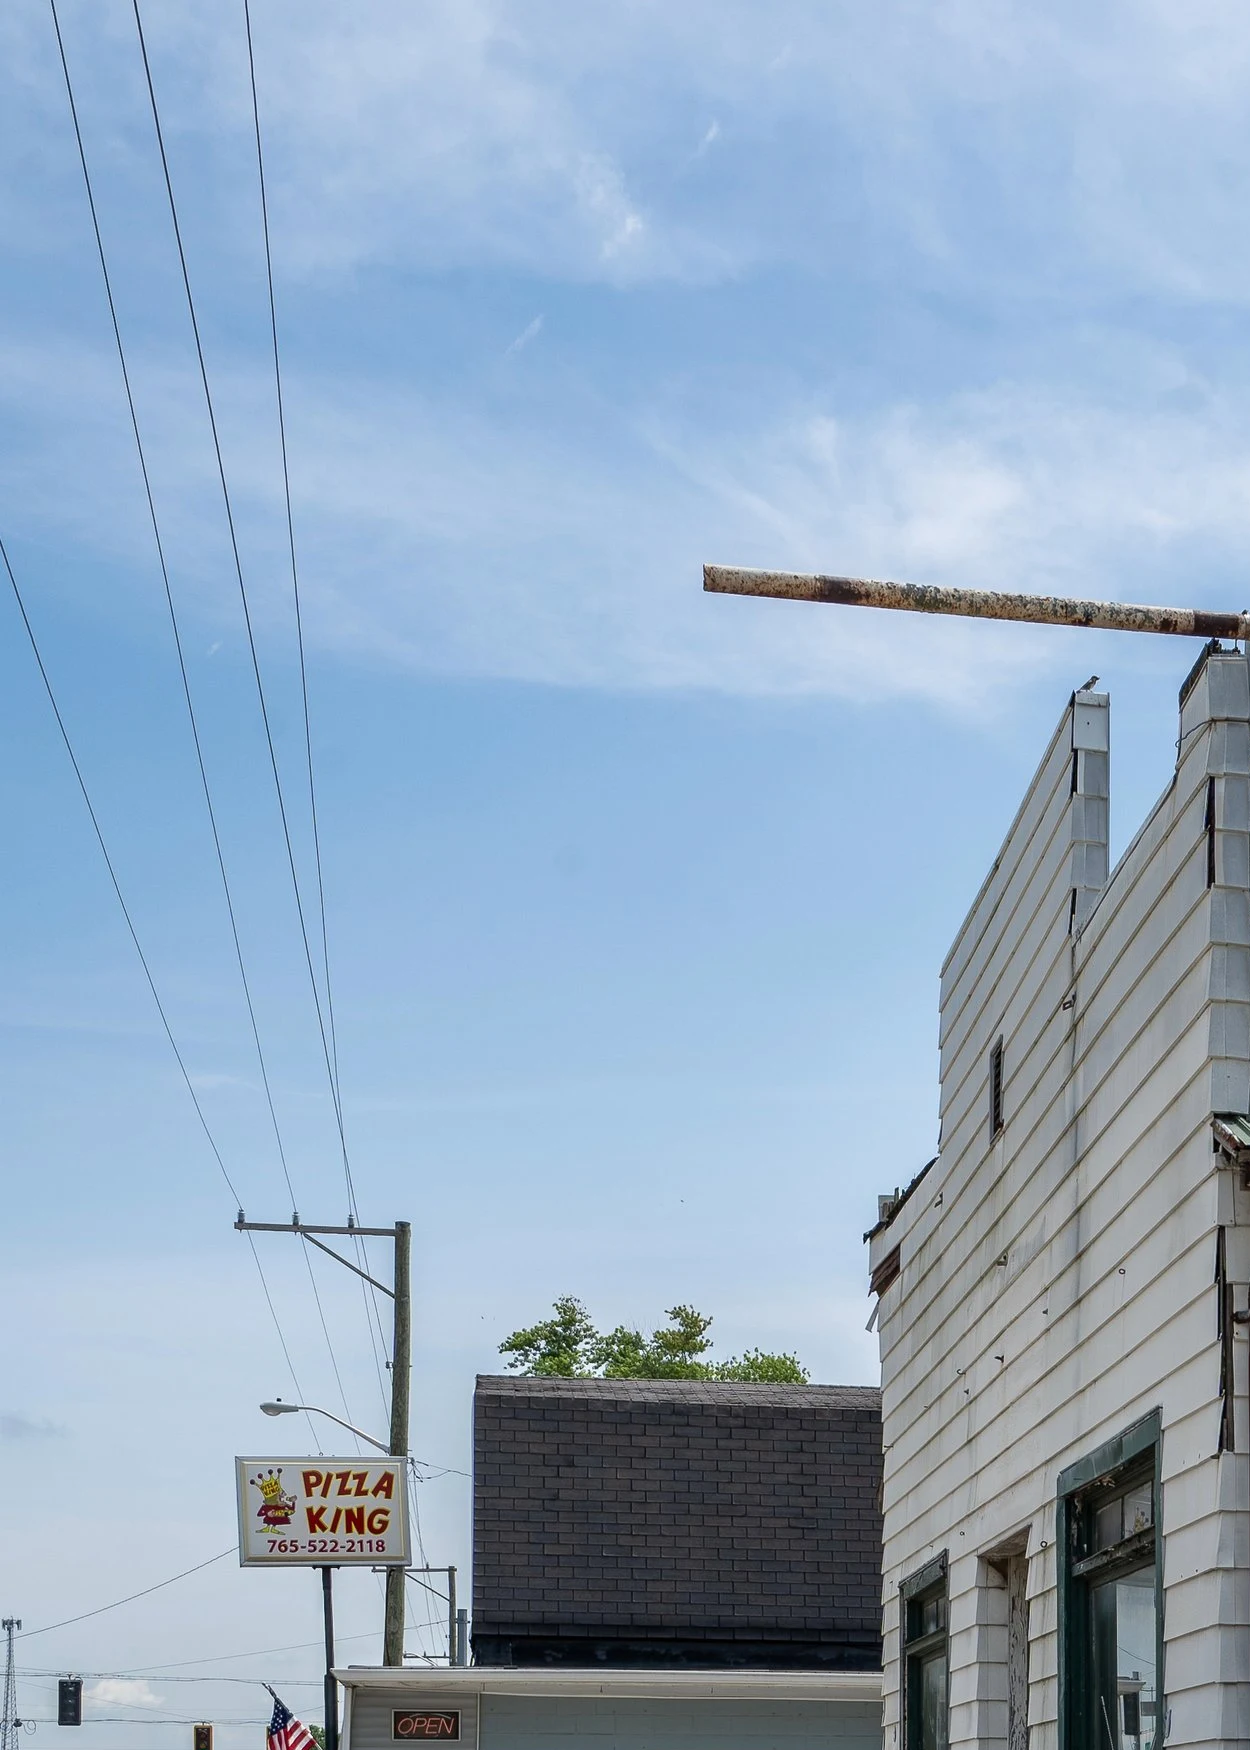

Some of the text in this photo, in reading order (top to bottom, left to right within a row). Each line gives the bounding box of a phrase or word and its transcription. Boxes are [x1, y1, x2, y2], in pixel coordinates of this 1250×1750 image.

[302, 1469, 395, 1499] PIZZA
[305, 1504, 392, 1535] KING
[267, 1539, 386, 1553] 765-522-2118
[398, 1717, 454, 1734] OPEN
